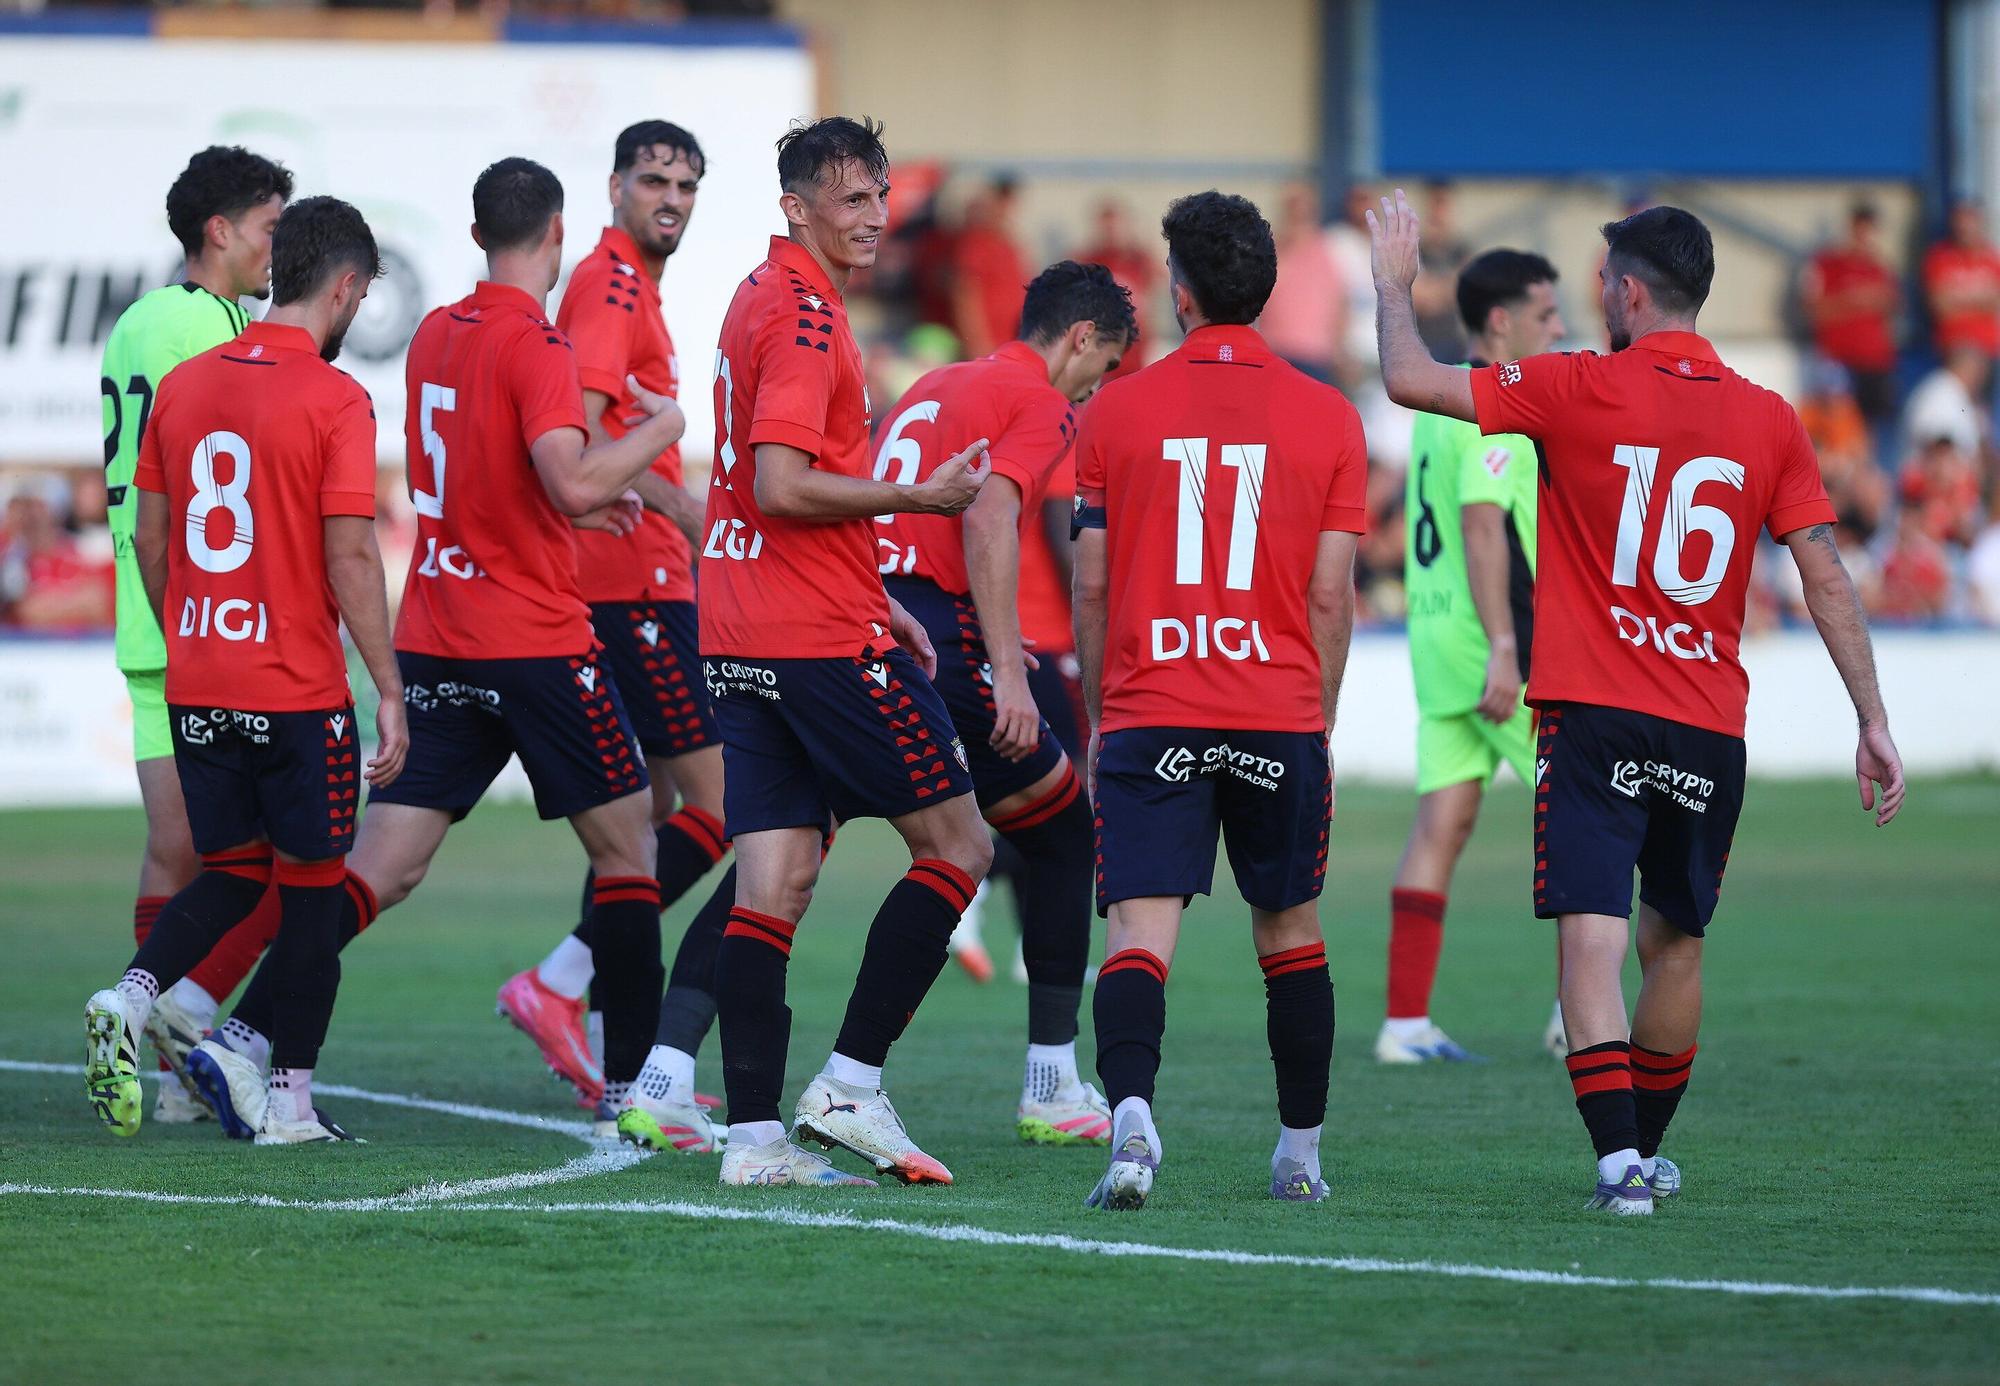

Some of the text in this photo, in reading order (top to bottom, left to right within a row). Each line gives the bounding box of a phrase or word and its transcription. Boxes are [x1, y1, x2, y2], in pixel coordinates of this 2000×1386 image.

[411, 382, 456, 519] 5
[873, 400, 941, 524] 6
[186, 431, 254, 573] 8
[1162, 437, 1268, 591] 11
[1611, 444, 1745, 606] 16
[179, 596, 268, 643] DIGI
[1151, 614, 1271, 662] DIGI
[1610, 605, 1719, 663] DIGI
[721, 661, 777, 686] CRYPTO
[210, 708, 269, 732] CPTO
[1203, 743, 1285, 778] CRYPTO
[1229, 765, 1278, 792] TRADER
[1643, 760, 1714, 797] CRYPTO
[1672, 790, 1707, 814] TRADER
